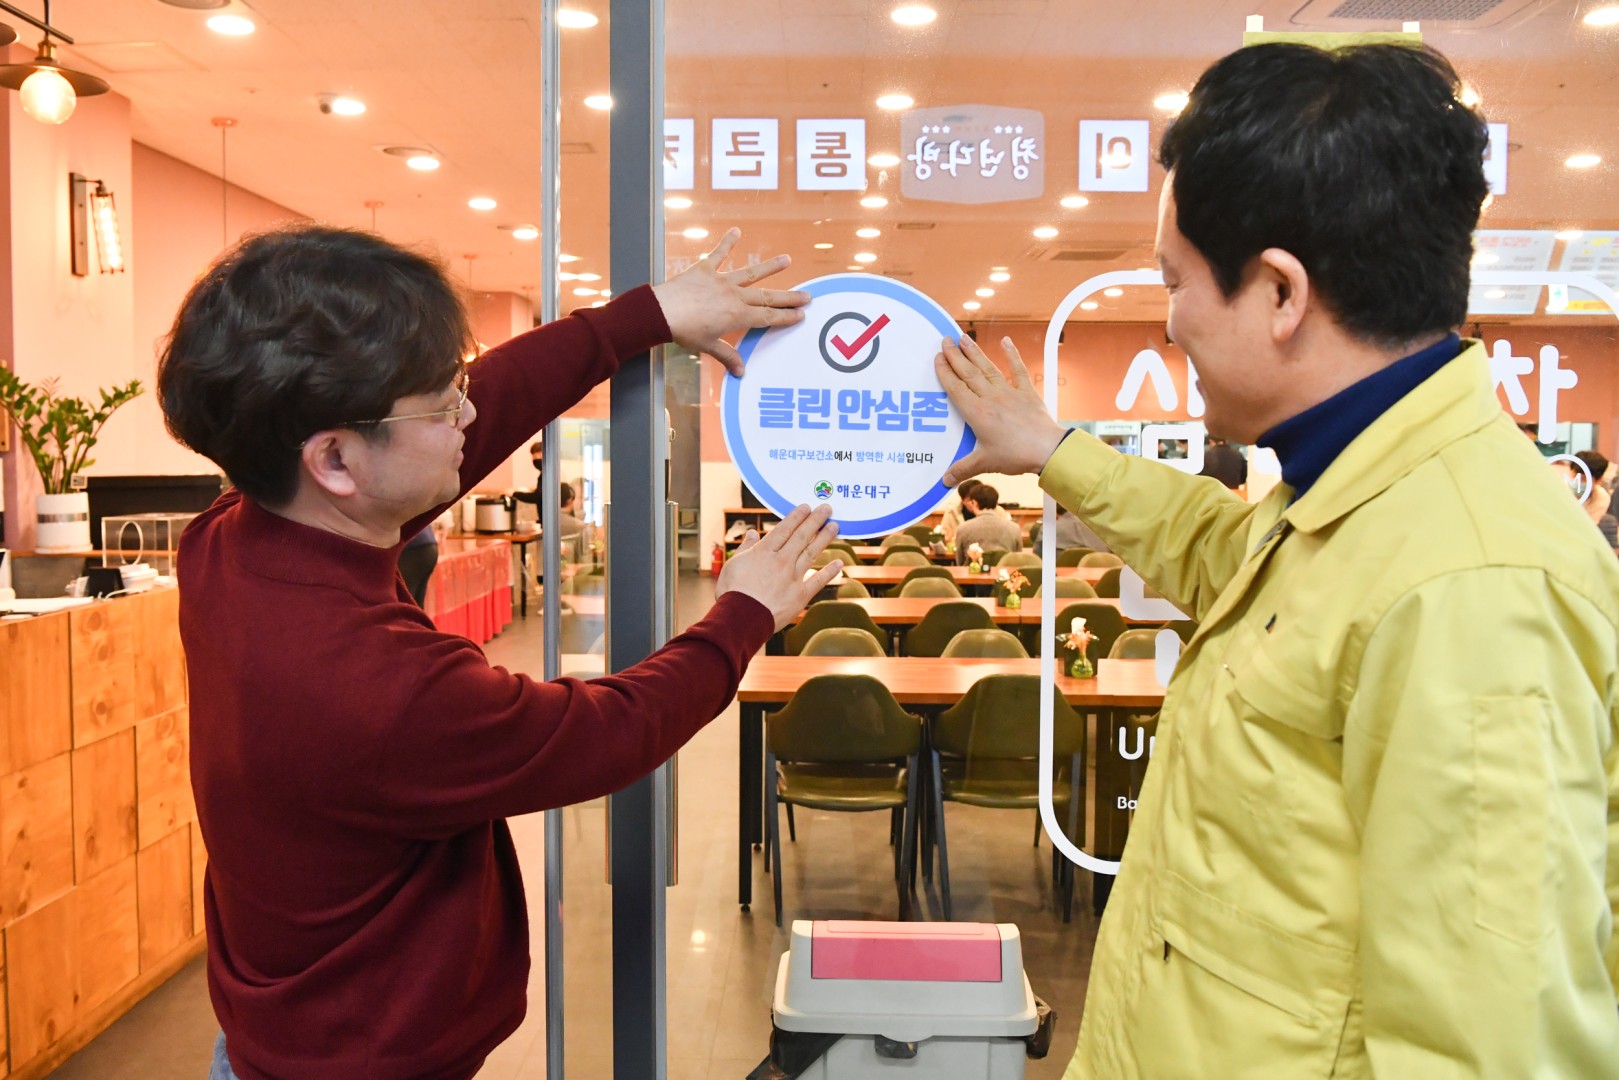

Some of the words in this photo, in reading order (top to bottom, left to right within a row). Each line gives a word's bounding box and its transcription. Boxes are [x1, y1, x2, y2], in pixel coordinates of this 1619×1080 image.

[758, 387, 831, 430] 클린
[837, 389, 949, 433] 안심존
[769, 449, 852, 461] 해운대구보건소에서
[856, 451, 884, 462] 방역한
[887, 452, 934, 464] 시설입니다
[836, 484, 891, 499] 해운대구
